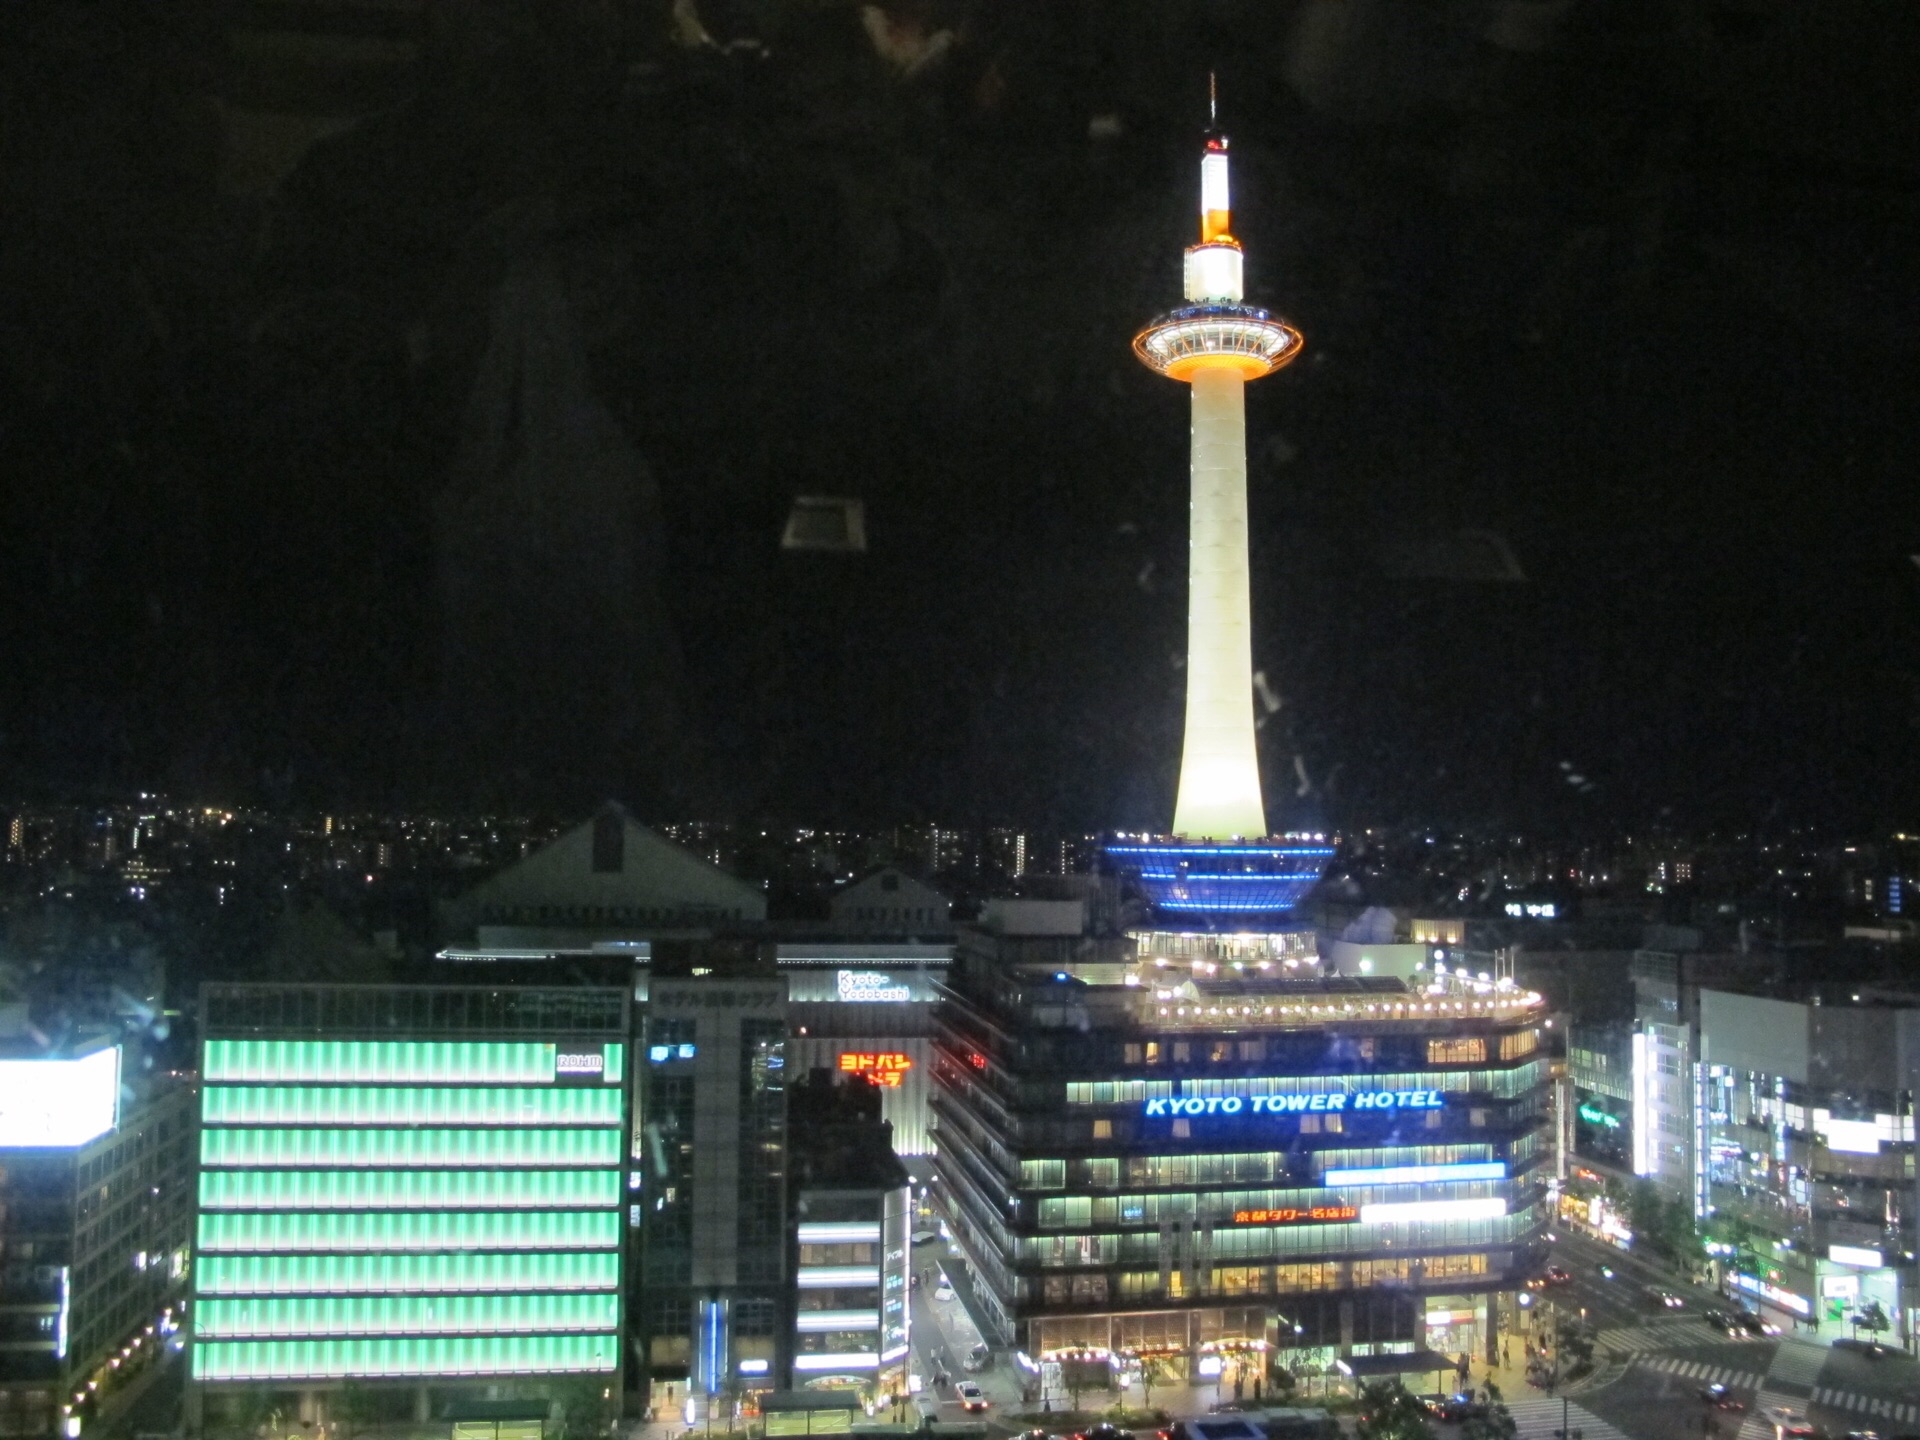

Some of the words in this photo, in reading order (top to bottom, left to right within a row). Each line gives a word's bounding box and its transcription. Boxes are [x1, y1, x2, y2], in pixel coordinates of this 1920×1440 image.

[658, 989, 778, 1008] ホテルクラブ
[840, 986, 909, 999] Yodobashi
[557, 1054, 603, 1068] ROHM
[841, 1054, 911, 1070] ヨドバシ
[864, 1071, 901, 1087] メラ
[1145, 1097, 1242, 1115] KYOTO
[1250, 1093, 1347, 1113] TOWER
[1354, 1090, 1443, 1110] HOTEL
[1234, 1206, 1357, 1223] 京都タワー名店街
